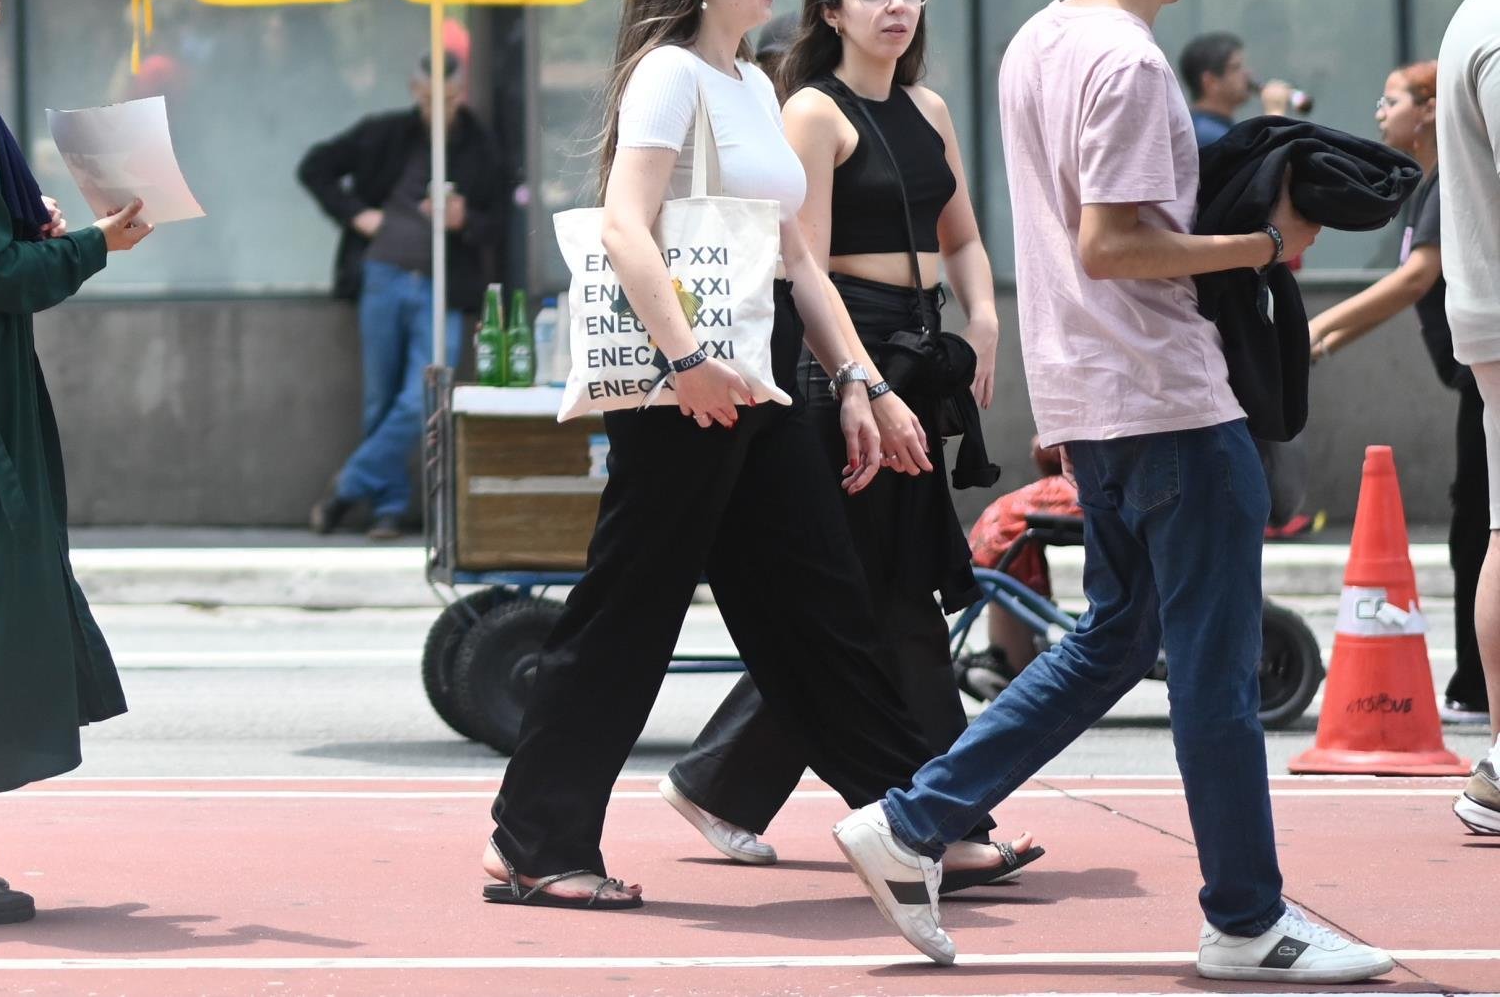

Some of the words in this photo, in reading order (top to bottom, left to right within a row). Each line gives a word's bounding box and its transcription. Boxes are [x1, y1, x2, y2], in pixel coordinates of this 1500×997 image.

[689, 247, 728, 266] XXI
[691, 277, 731, 296] XXI
[694, 308, 733, 327] XXI
